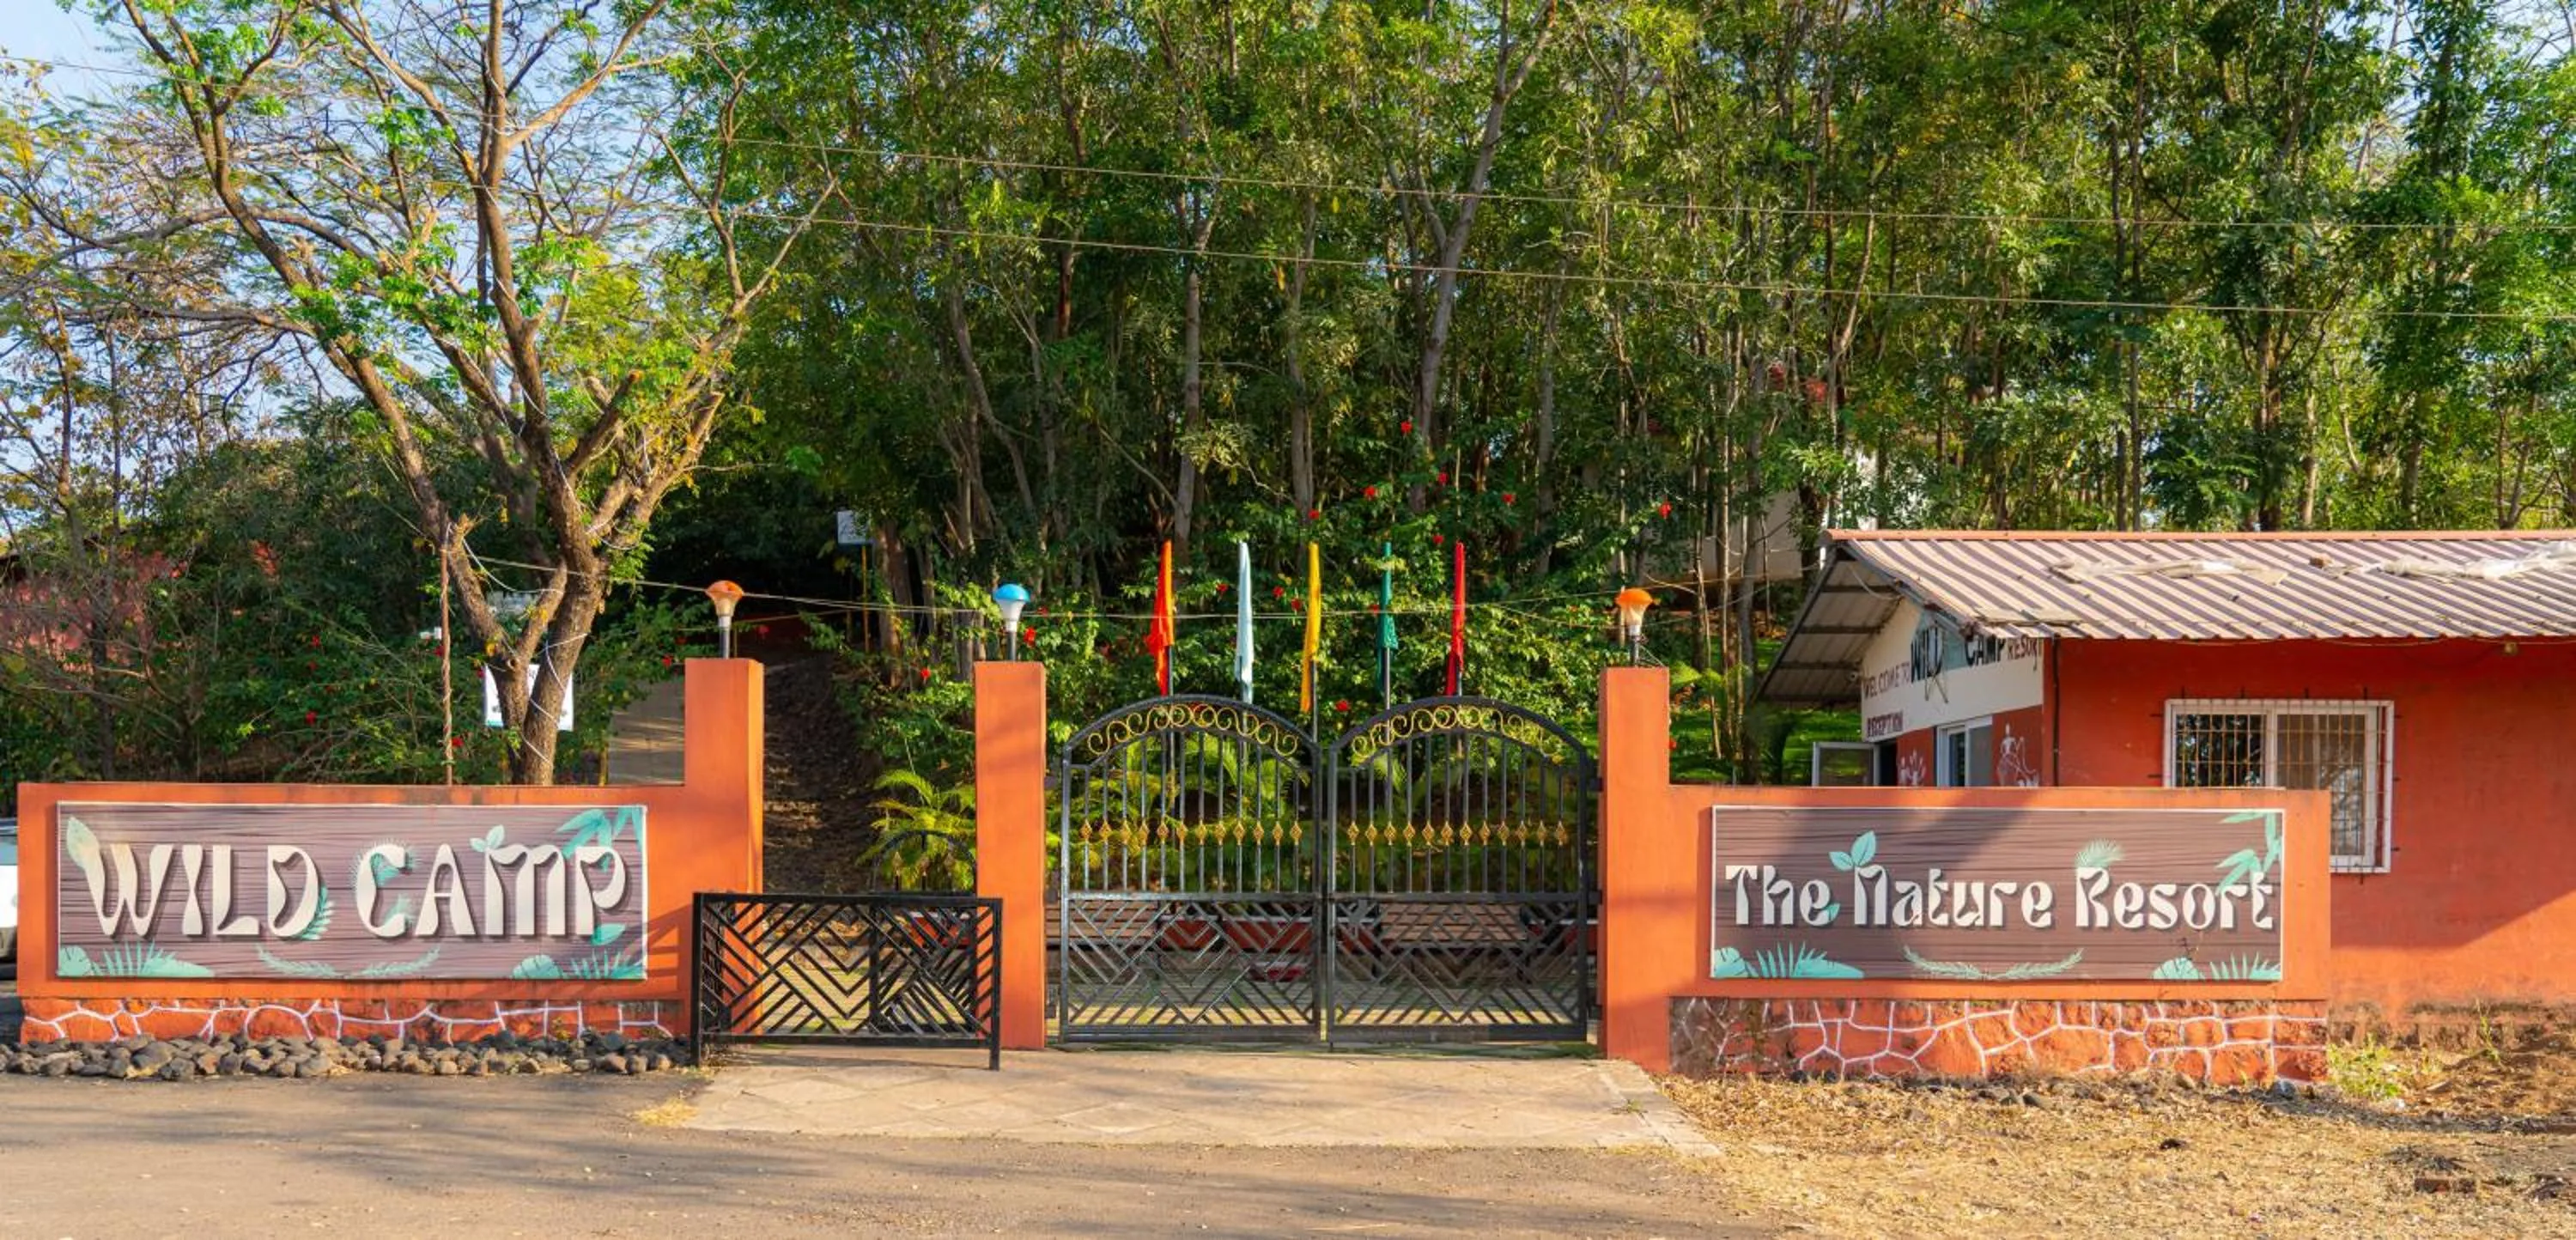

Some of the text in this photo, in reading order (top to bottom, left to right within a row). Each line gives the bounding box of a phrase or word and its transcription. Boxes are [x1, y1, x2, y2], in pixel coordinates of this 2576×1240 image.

[1911, 625, 1942, 684] WILD
[1964, 634, 2006, 667] CAMP
[1867, 710, 1904, 738] RECEPTION
[79, 842, 628, 938] WILD CAMP
[1724, 864, 2274, 930] The Nature Resort
